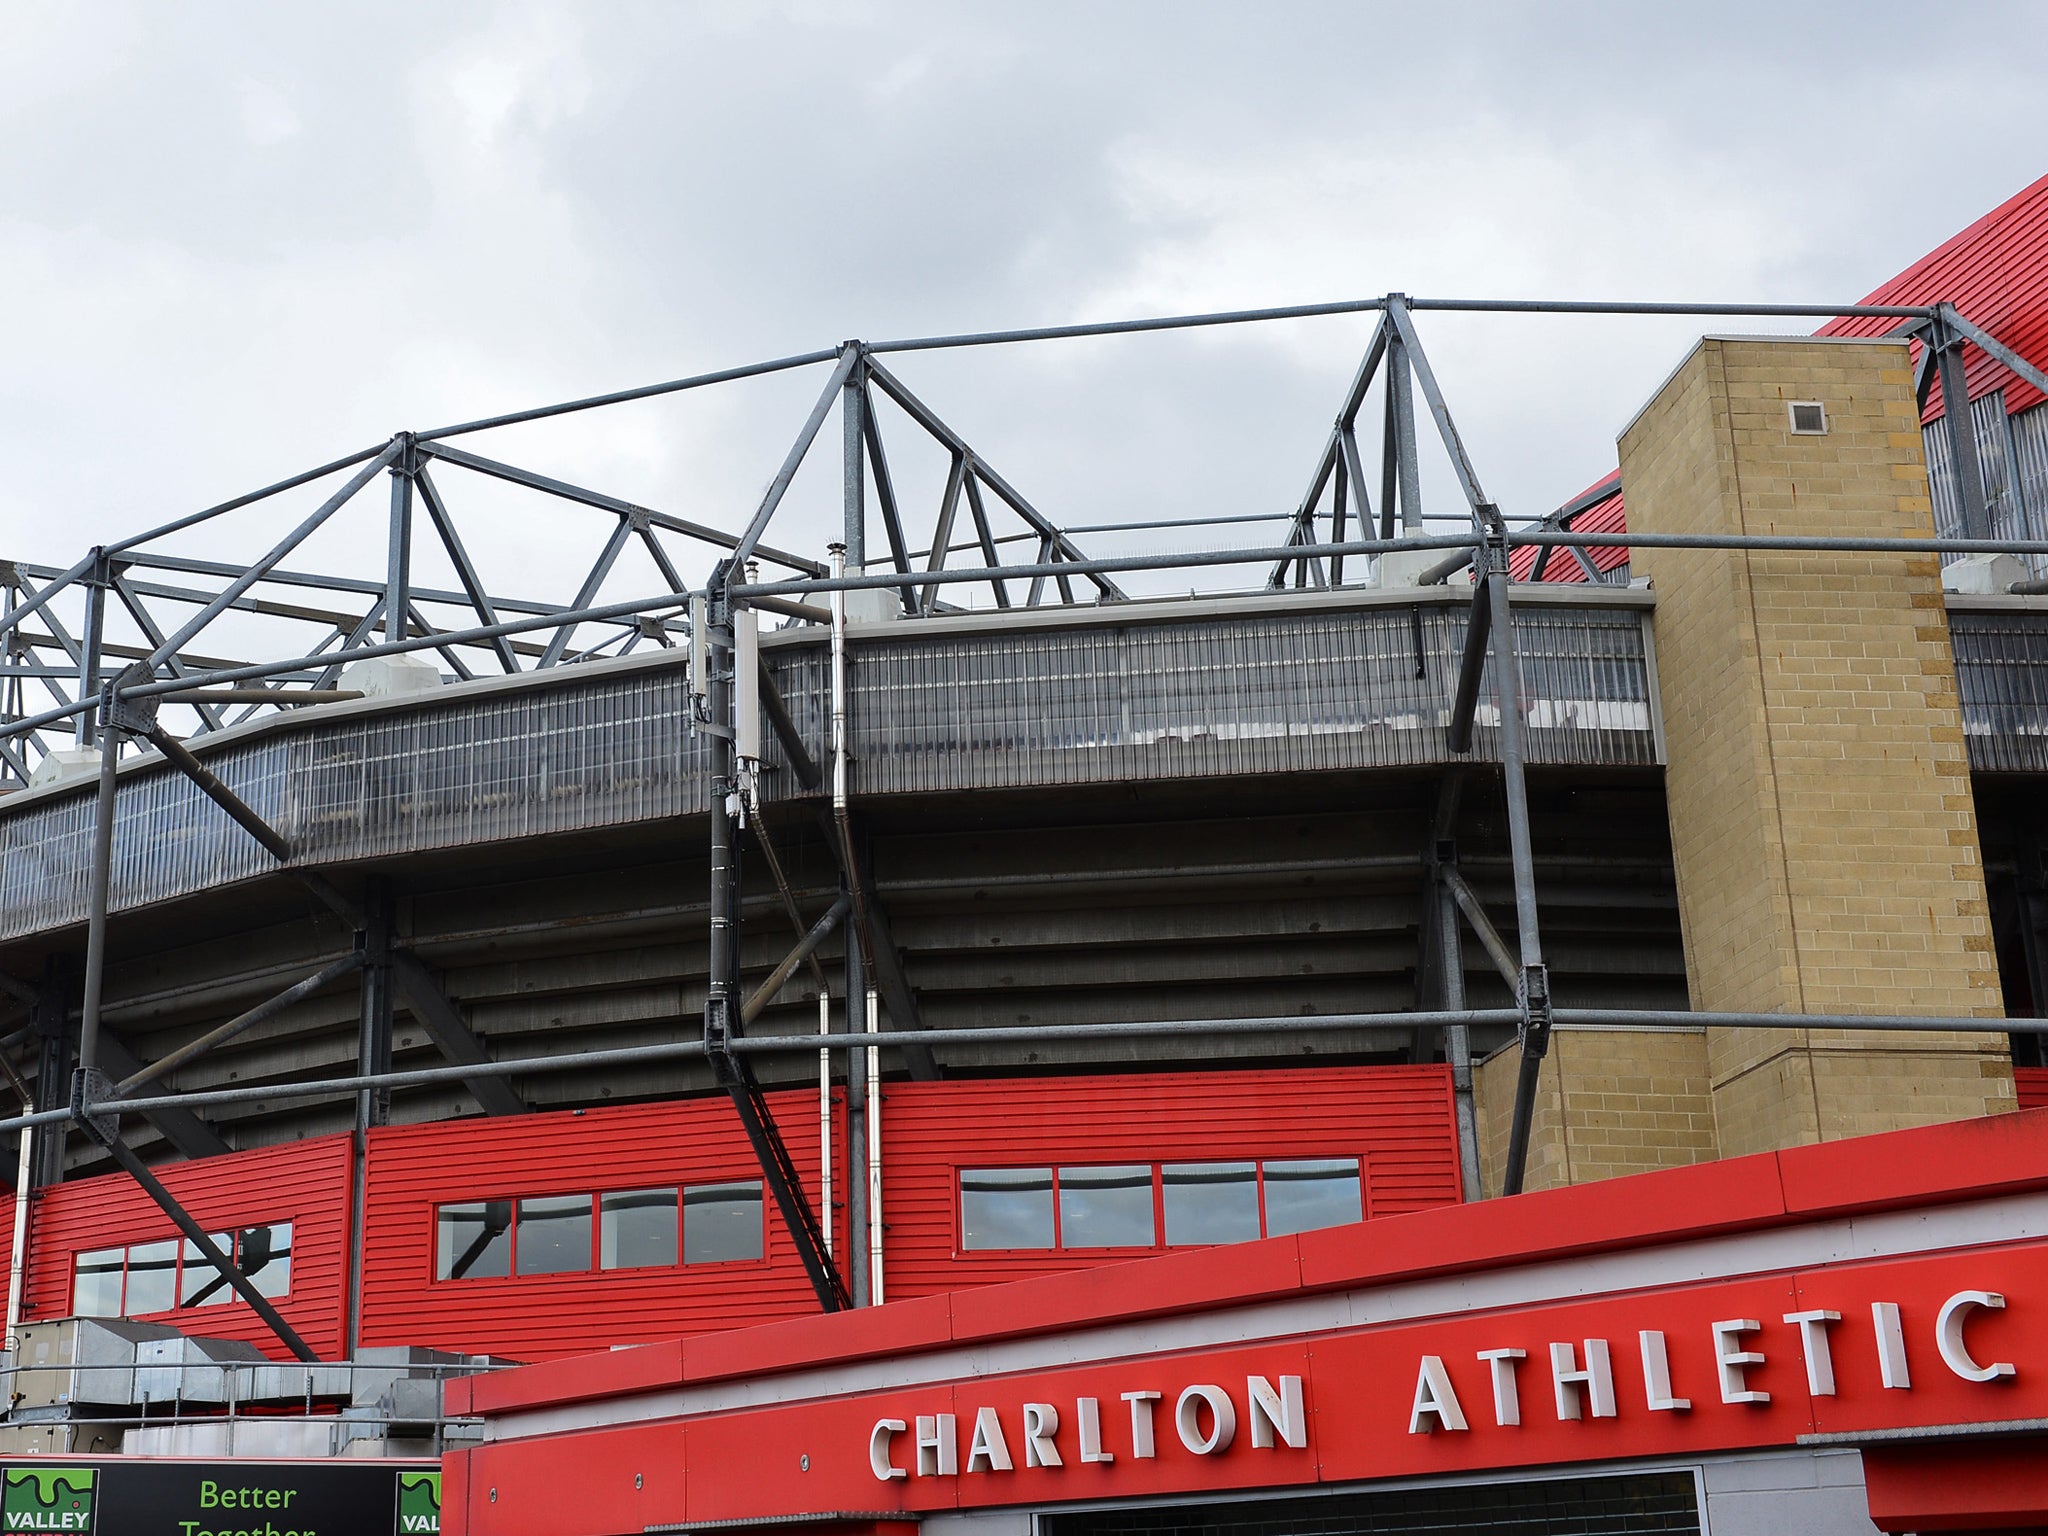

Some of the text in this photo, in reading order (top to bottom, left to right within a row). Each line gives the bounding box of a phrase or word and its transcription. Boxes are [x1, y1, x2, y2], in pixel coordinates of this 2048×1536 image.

[869, 1290, 2016, 1481] CHARLTON ATHLETIC
[200, 1480, 297, 1509] Better
[6, 1512, 90, 1529] VALLEY
